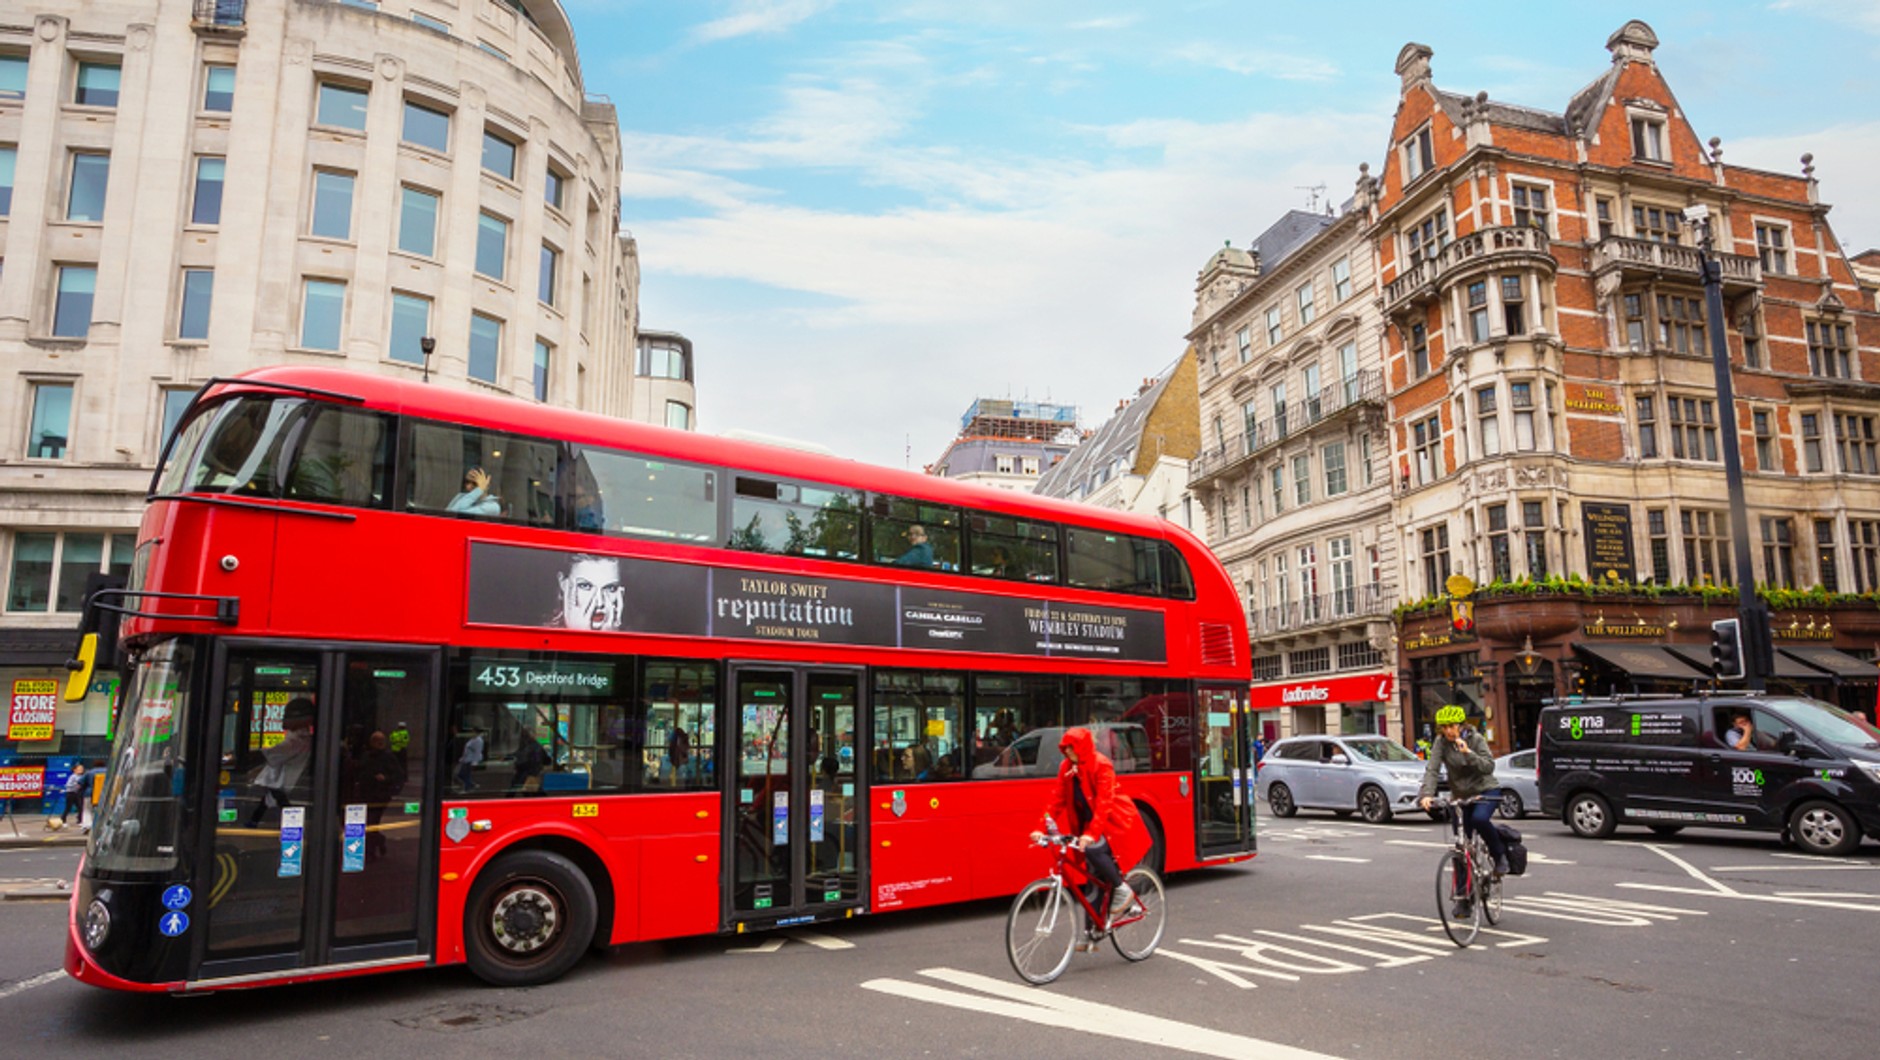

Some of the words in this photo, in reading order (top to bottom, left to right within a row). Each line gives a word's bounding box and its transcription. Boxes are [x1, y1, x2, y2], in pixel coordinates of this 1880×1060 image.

[740, 577, 787, 596] TAYLOR
[790, 583, 828, 599] SWIFT
[717, 597, 854, 626] reputation
[755, 626, 794, 637] STADIUM
[796, 627, 819, 639] TOUR
[1028, 619, 1080, 636] WEMBLEY
[1082, 623, 1125, 639] STADIUM
[1585, 625, 1604, 635] THE
[1605, 625, 1665, 636] WELLINGTON
[476, 666, 521, 687] 453
[526, 671, 574, 687] Deptford
[577, 672, 608, 689] Bridge
[14, 695, 56, 710] STORE
[1282, 685, 1329, 703] Ladbrokes
[12, 710, 54, 723] CLOSING
[1560, 715, 1604, 739] sigma
